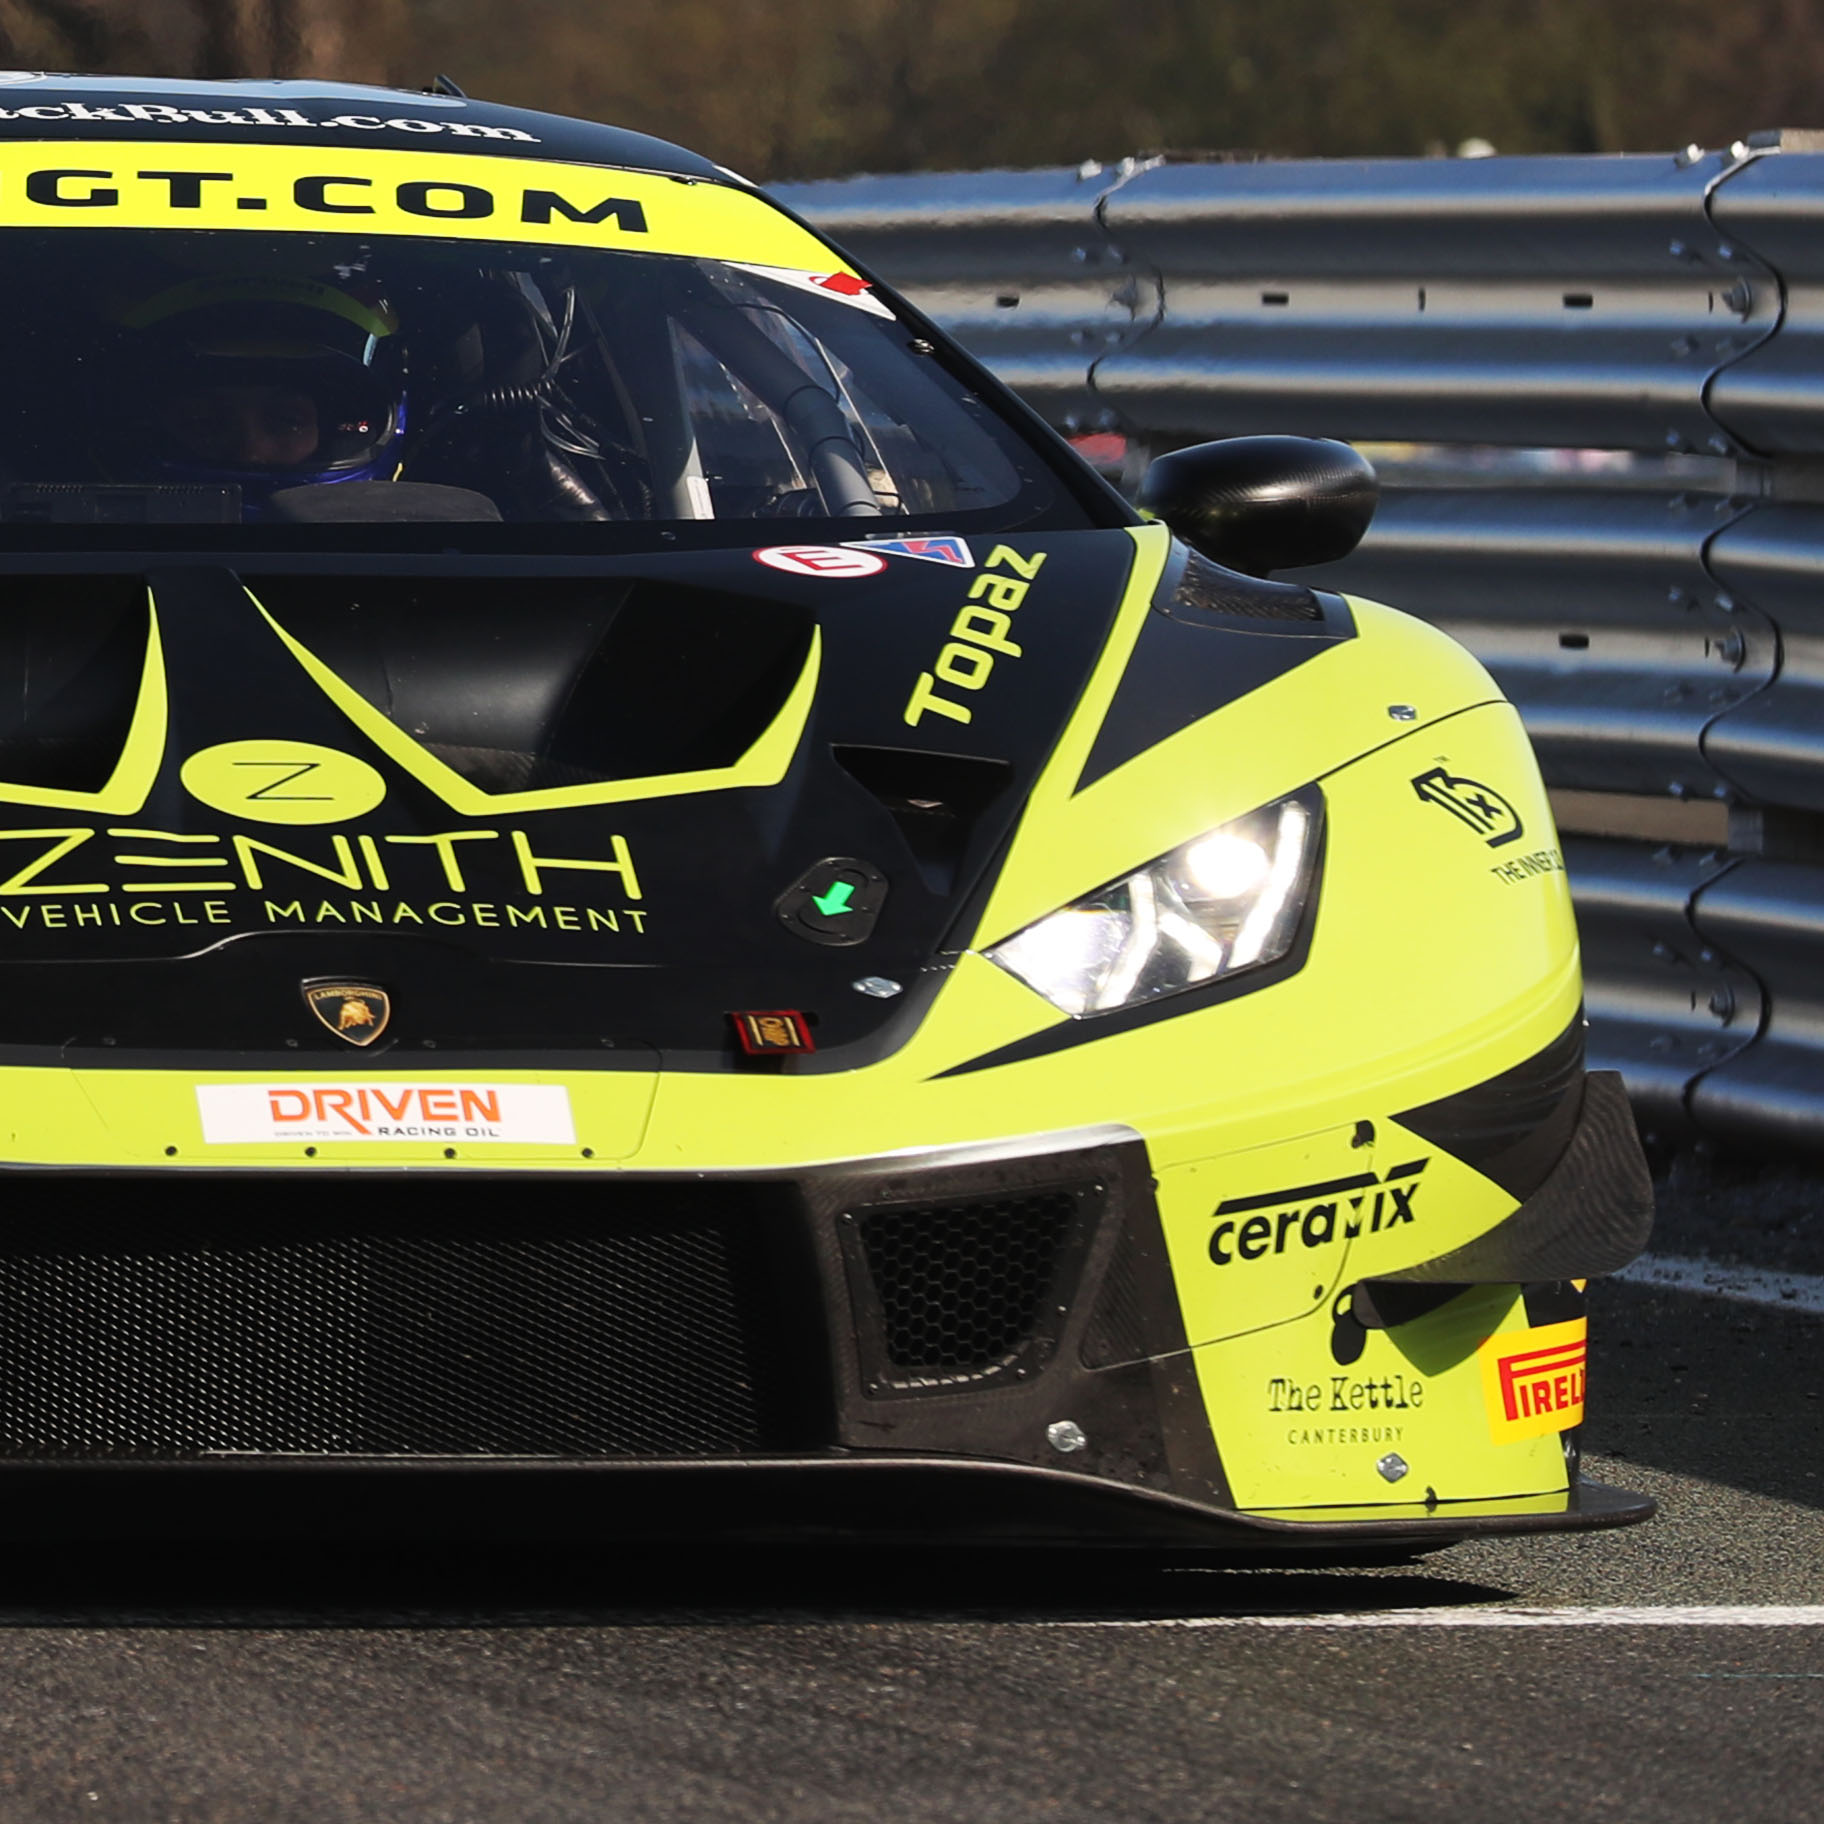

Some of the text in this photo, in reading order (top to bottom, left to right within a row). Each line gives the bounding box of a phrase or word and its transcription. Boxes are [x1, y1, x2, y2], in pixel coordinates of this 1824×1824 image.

[903, 543, 1047, 728] Topaz
[1, 900, 649, 933] VEHICLE MANAGEMENT
[267, 1088, 502, 1135] DRIVEN
[377, 1126, 500, 1138] RACING OIL
[1267, 1373, 1425, 1414] The Kettle
[1286, 1426, 1405, 1446] CANTERBURY
